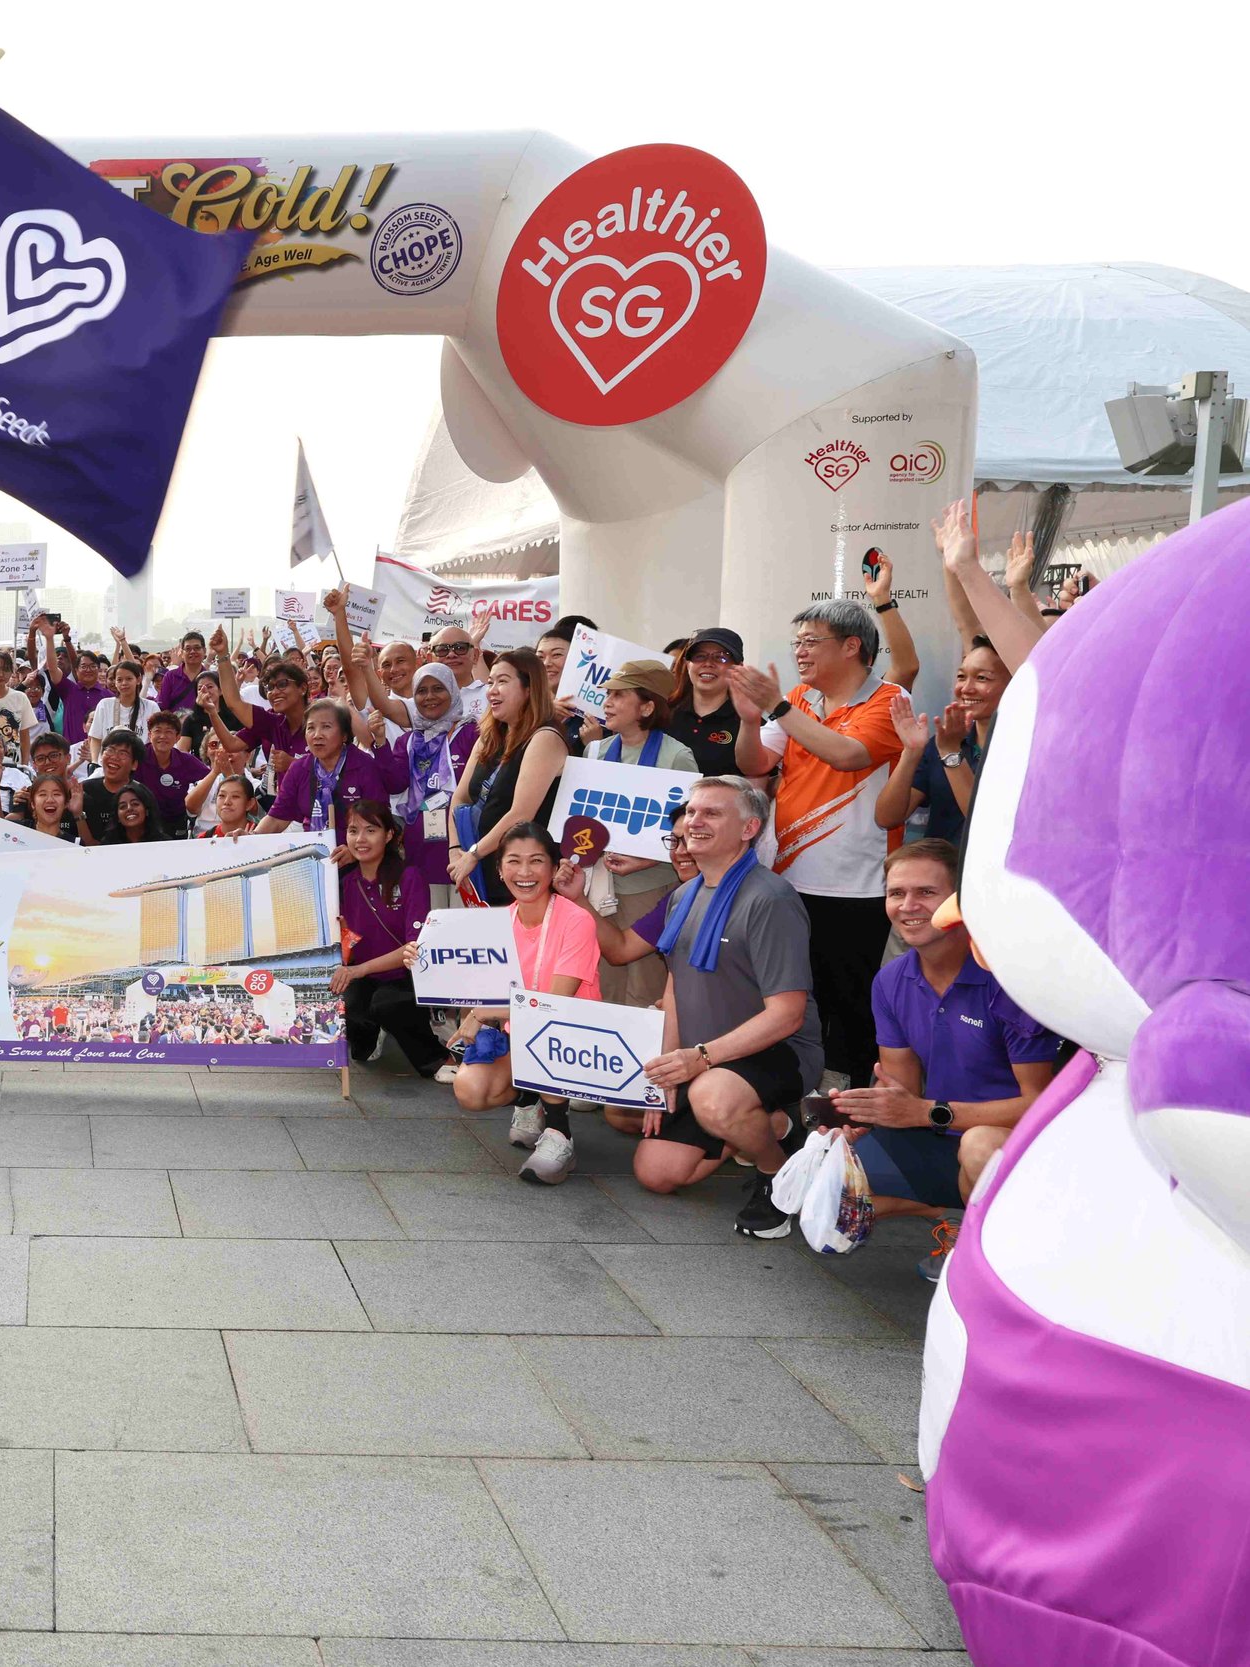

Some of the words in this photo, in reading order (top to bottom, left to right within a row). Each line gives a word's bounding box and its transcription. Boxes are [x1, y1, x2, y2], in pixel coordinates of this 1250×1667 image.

[161, 162, 395, 234] Gold!
[379, 213, 413, 252] BLOSSOM
[413, 211, 443, 227] SEEDS
[521, 186, 742, 287] Healthier
[254, 254, 280, 269] Age
[284, 248, 313, 262] Well
[377, 227, 454, 275] CHOPE
[387, 273, 410, 288] ACTIVE
[410, 273, 436, 288] AGEING
[435, 249, 454, 281] CENTRE
[575, 284, 664, 338] SG
[852, 413, 900, 425] Supported
[902, 412, 913, 422] by
[804, 439, 871, 466] Healthier
[823, 463, 850, 478] SG
[889, 453, 928, 472] aic
[863, 522, 920, 531] Administrator
[0, 565, 21, 573] Zone
[811, 590, 867, 601] MINTRY
[889, 589, 929, 600] HEALTH
[351, 602, 376, 615] Meridian
[471, 599, 553, 623] CARES
[424, 615, 464, 629] AmChamSG
[577, 683, 605, 707] Hea
[430, 947, 508, 965] IPSEN
[250, 982, 266, 991] 60
[251, 973, 268, 982] SG
[959, 1013, 984, 1028] sanofi
[8, 1046, 43, 1057] Serve
[46, 1047, 72, 1058] with
[74, 1047, 105, 1060] Love
[108, 1049, 132, 1058] and
[135, 1048, 166, 1060] Care
[548, 1035, 624, 1075] Roche
